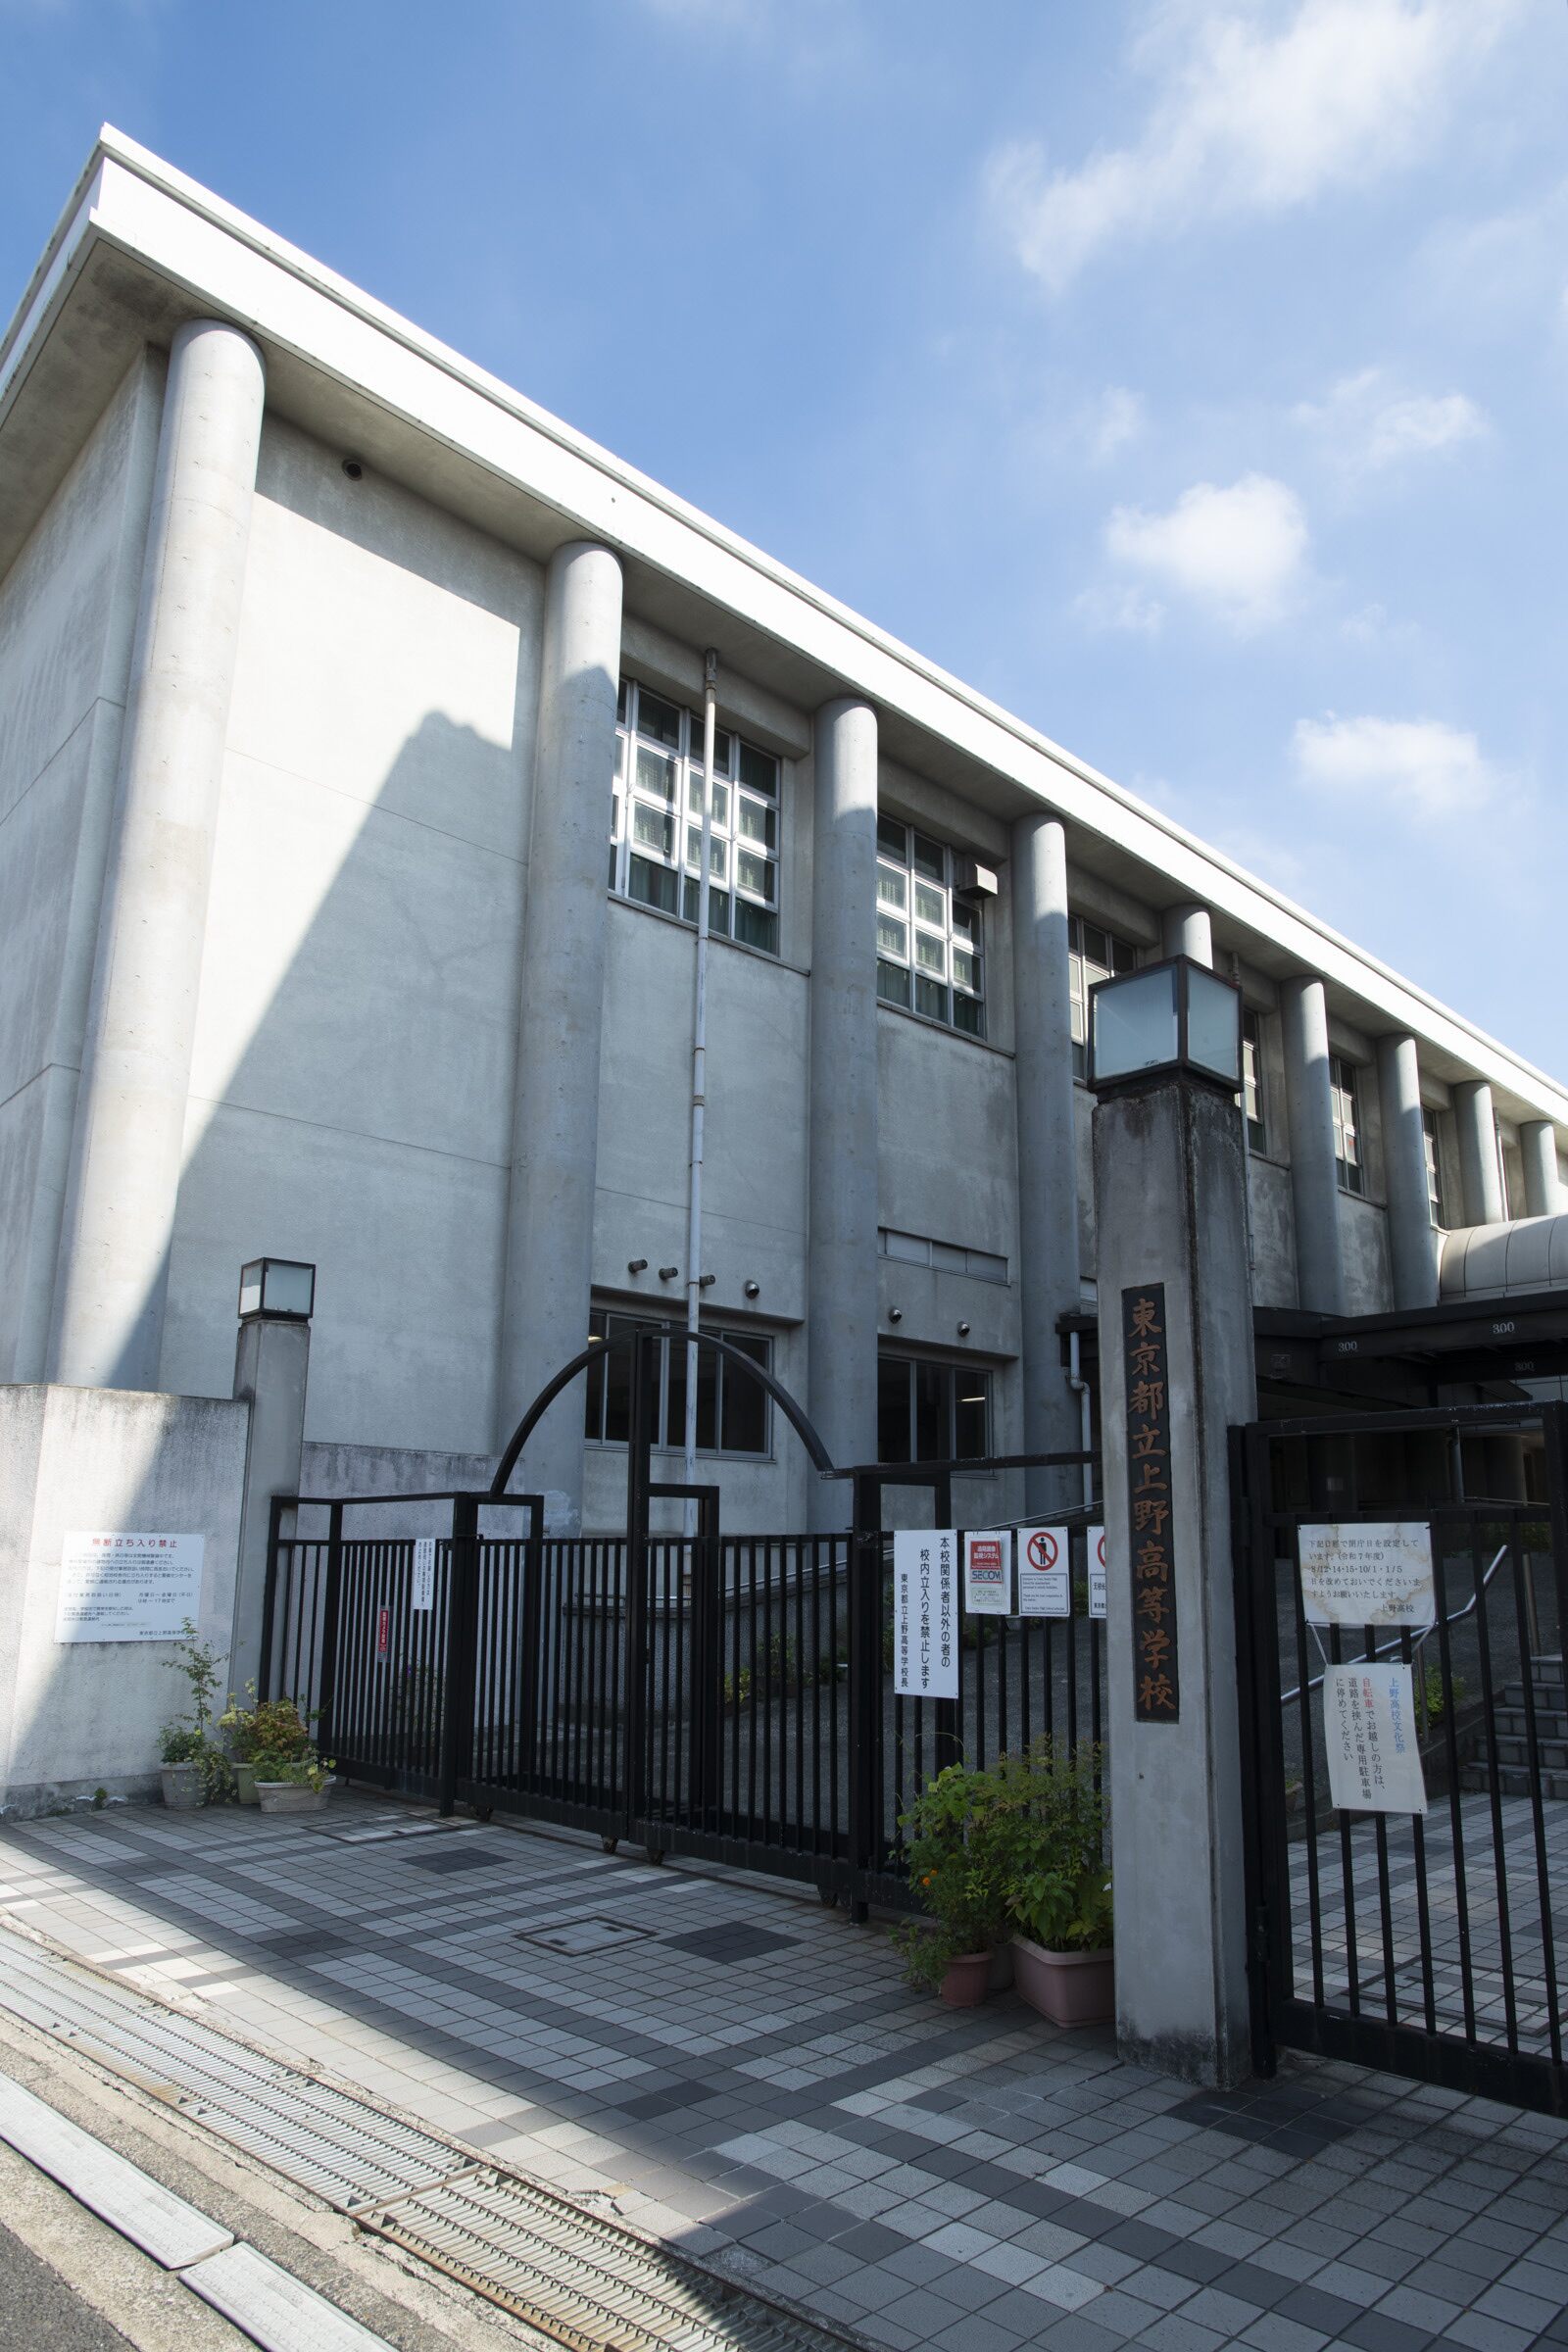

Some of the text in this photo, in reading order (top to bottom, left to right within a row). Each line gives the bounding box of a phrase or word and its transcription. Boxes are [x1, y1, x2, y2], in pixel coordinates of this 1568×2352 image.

[1338, 1340, 1358, 1352] 300
[1493, 1321, 1515, 1335] 300
[1128, 1298, 1176, 1710] 東京都立上野高等学校
[919, 1548, 931, 1690] 校内立入りを禁止します
[939, 1537, 952, 1668] 本校関係者以外の者の
[971, 1570, 1001, 1581] SECOM
[1381, 1603, 1415, 1614] 上野高校
[900, 1574, 909, 1688] 東京都立上野高等学校長
[1336, 1679, 1353, 1761] に停めてください
[1348, 1677, 1372, 1799] 道路を挟んだ専用駐車場
[1363, 1677, 1386, 1790] 自転車でお越しの方は、
[1389, 1677, 1406, 1754] 上野高校文化祭
